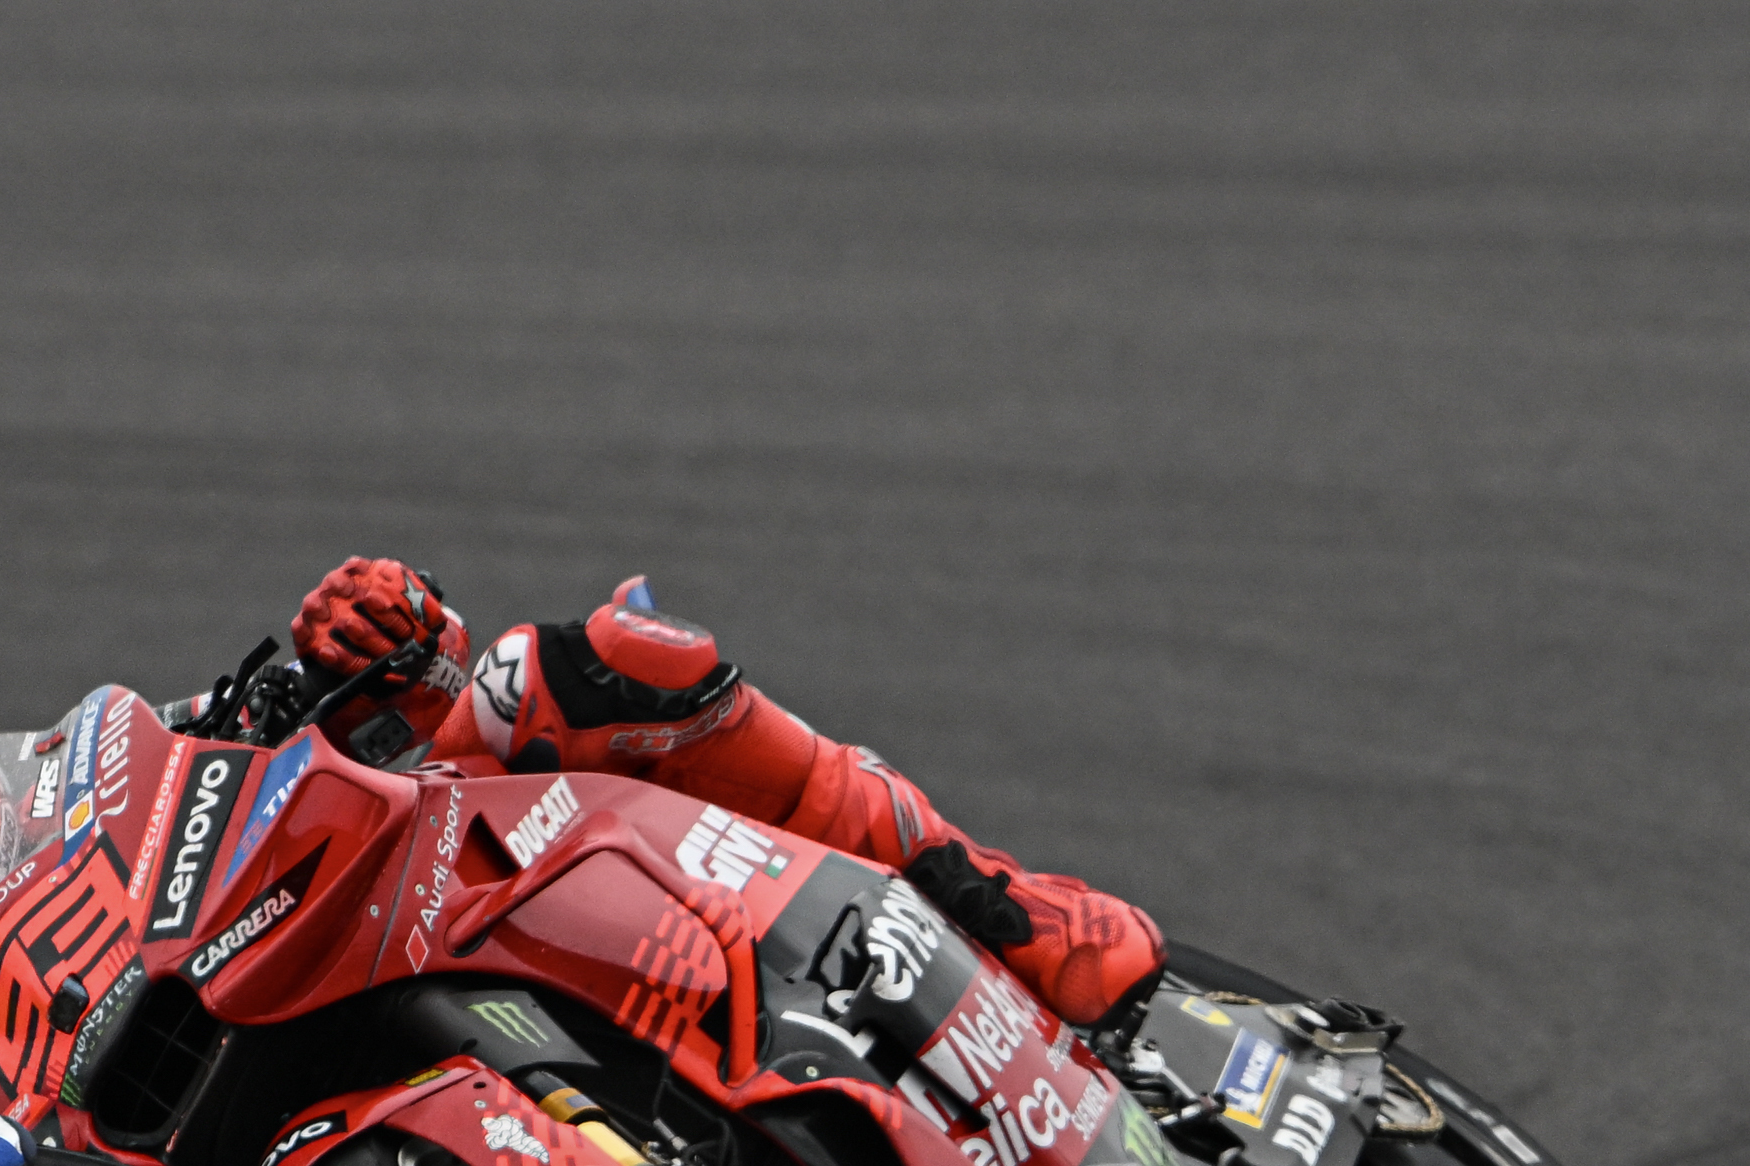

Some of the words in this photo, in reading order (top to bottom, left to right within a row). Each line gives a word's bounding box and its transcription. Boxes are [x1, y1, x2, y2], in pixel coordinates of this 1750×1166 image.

[31, 758, 60, 818] WRS
[70, 699, 100, 785] ADVANCE
[129, 741, 185, 900] FRECCIAROSSA
[152, 758, 230, 932] Lenovo
[420, 860, 450, 932] Audi
[436, 783, 463, 862] Sport
[505, 775, 581, 869] DUCATI
[191, 888, 295, 978] CARRERA
[70, 966, 142, 1076] MONSTER
